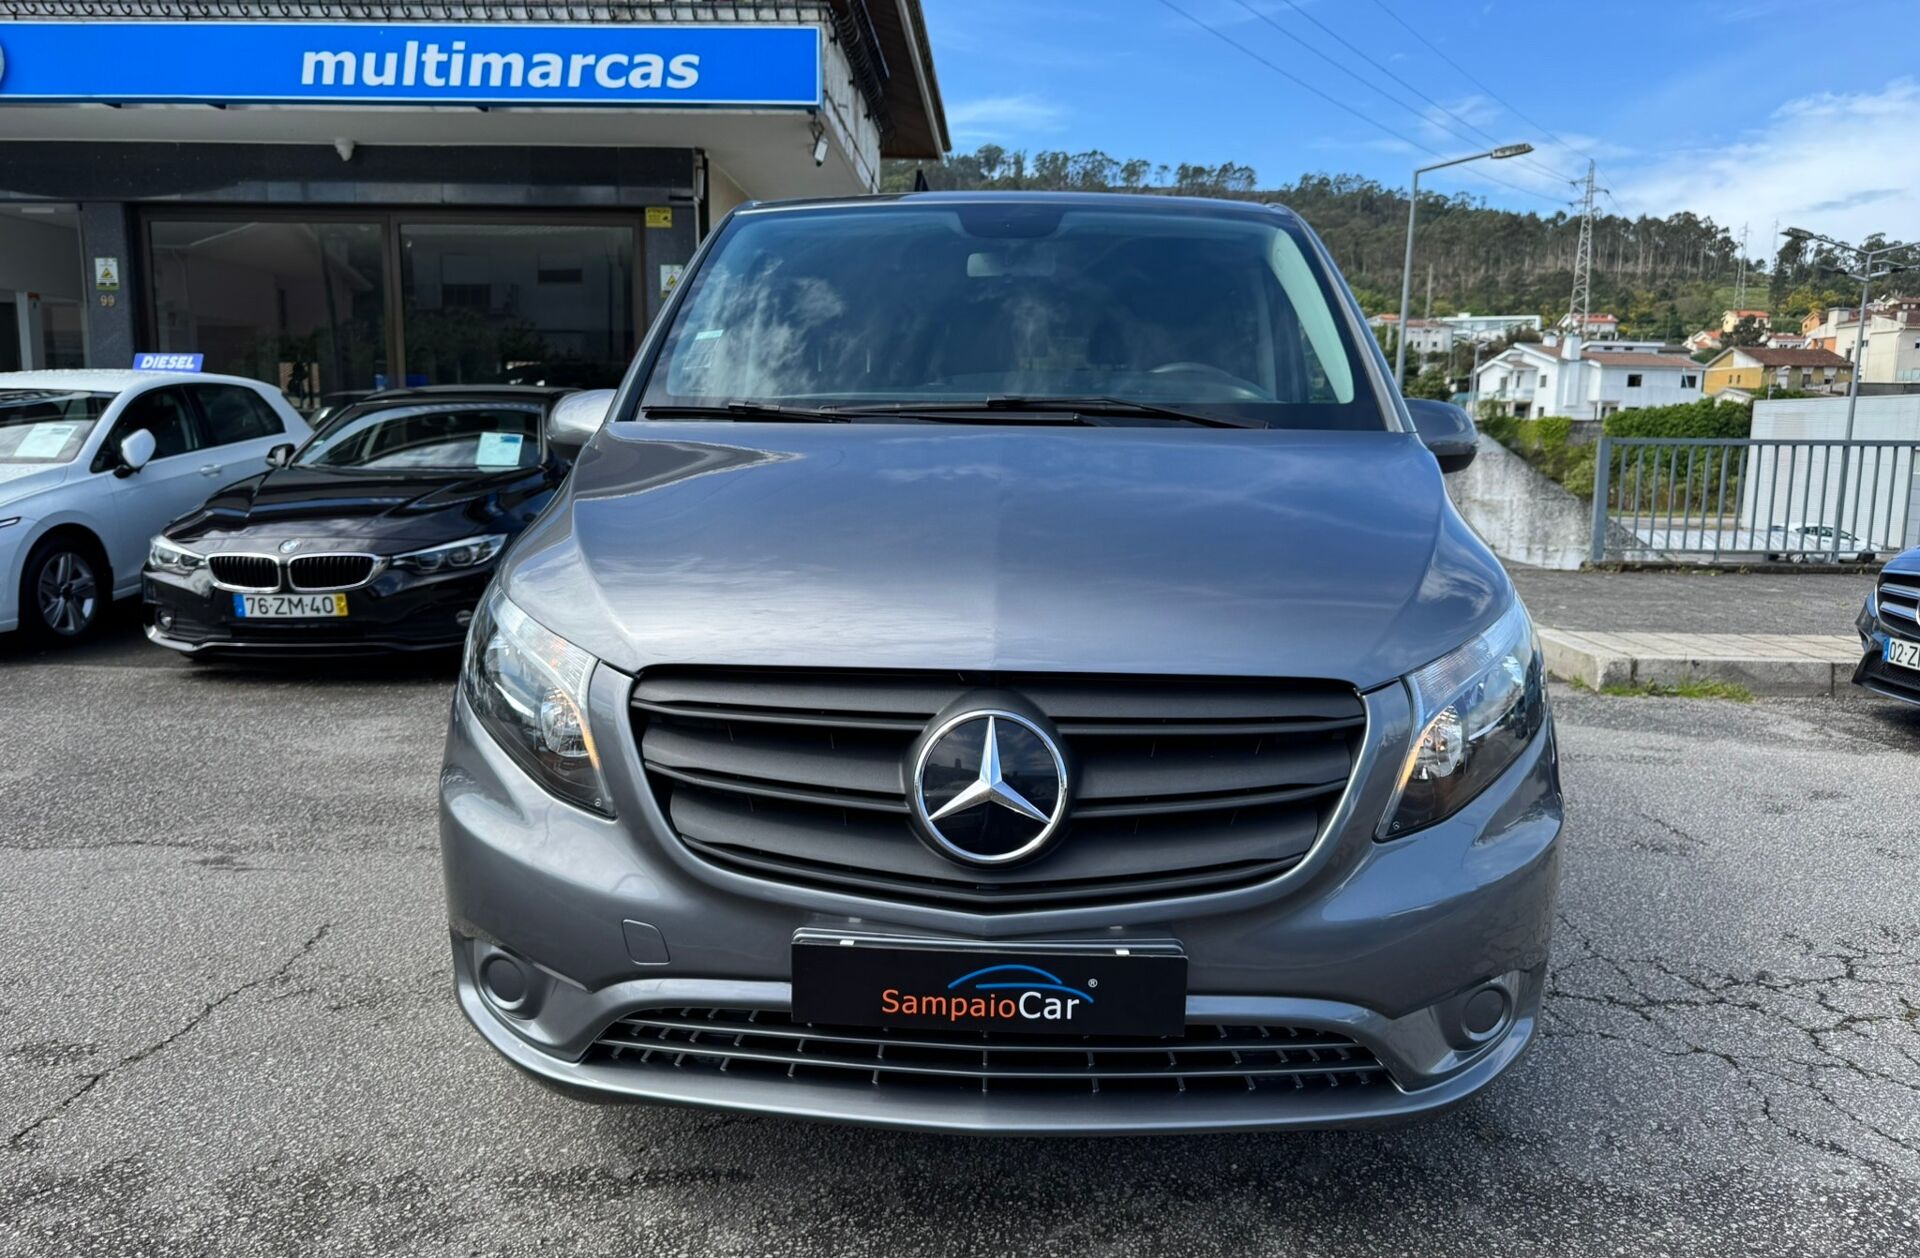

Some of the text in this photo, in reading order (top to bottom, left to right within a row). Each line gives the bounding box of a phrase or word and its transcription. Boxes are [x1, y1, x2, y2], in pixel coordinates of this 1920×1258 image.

[301, 41, 700, 89] multimarcas
[100, 294, 115, 306] 99
[140, 355, 195, 369] DIESEL
[881, 989, 1080, 1021] SampaioCar
